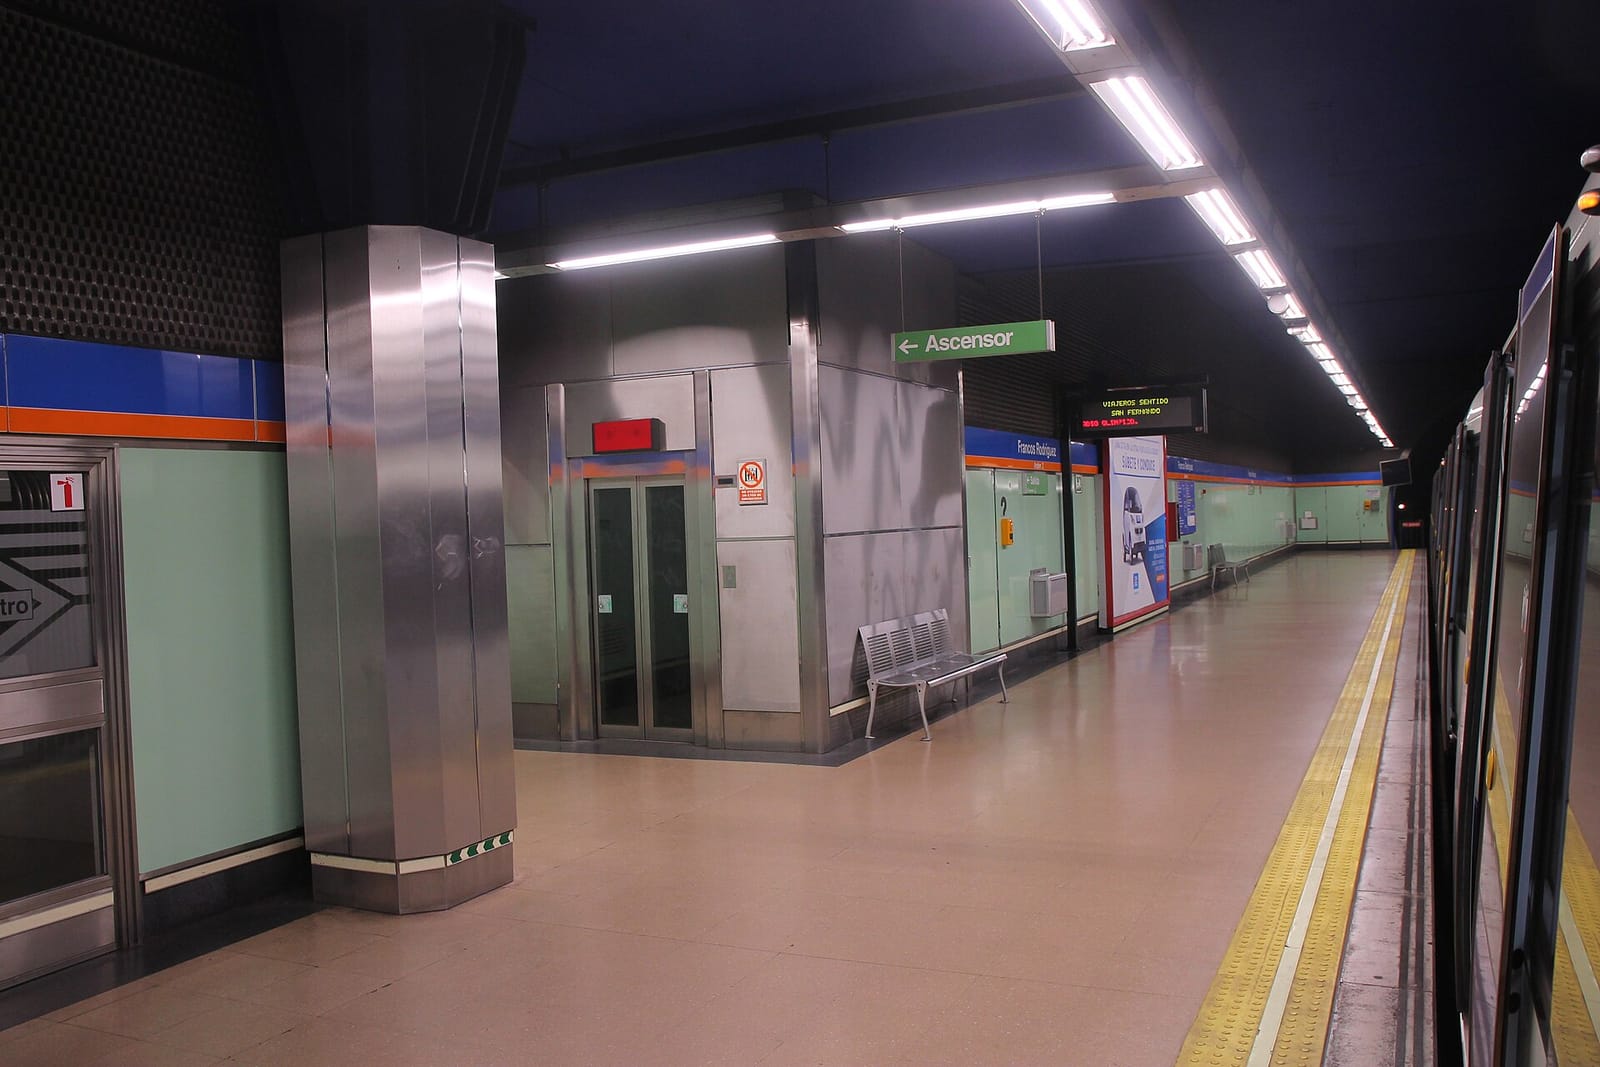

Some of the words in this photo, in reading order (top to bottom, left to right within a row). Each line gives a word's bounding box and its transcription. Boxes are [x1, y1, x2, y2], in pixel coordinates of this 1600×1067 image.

[925, 331, 1014, 353] Ascensor
[1102, 399, 1136, 408] VIAJEROS
[1139, 397, 1169, 406] SENTIDO
[1111, 409, 1124, 417] SAN
[1127, 407, 1161, 416] FERNANDO
[1017, 439, 1036, 455] Francos
[0, 598, 29, 616] tro
